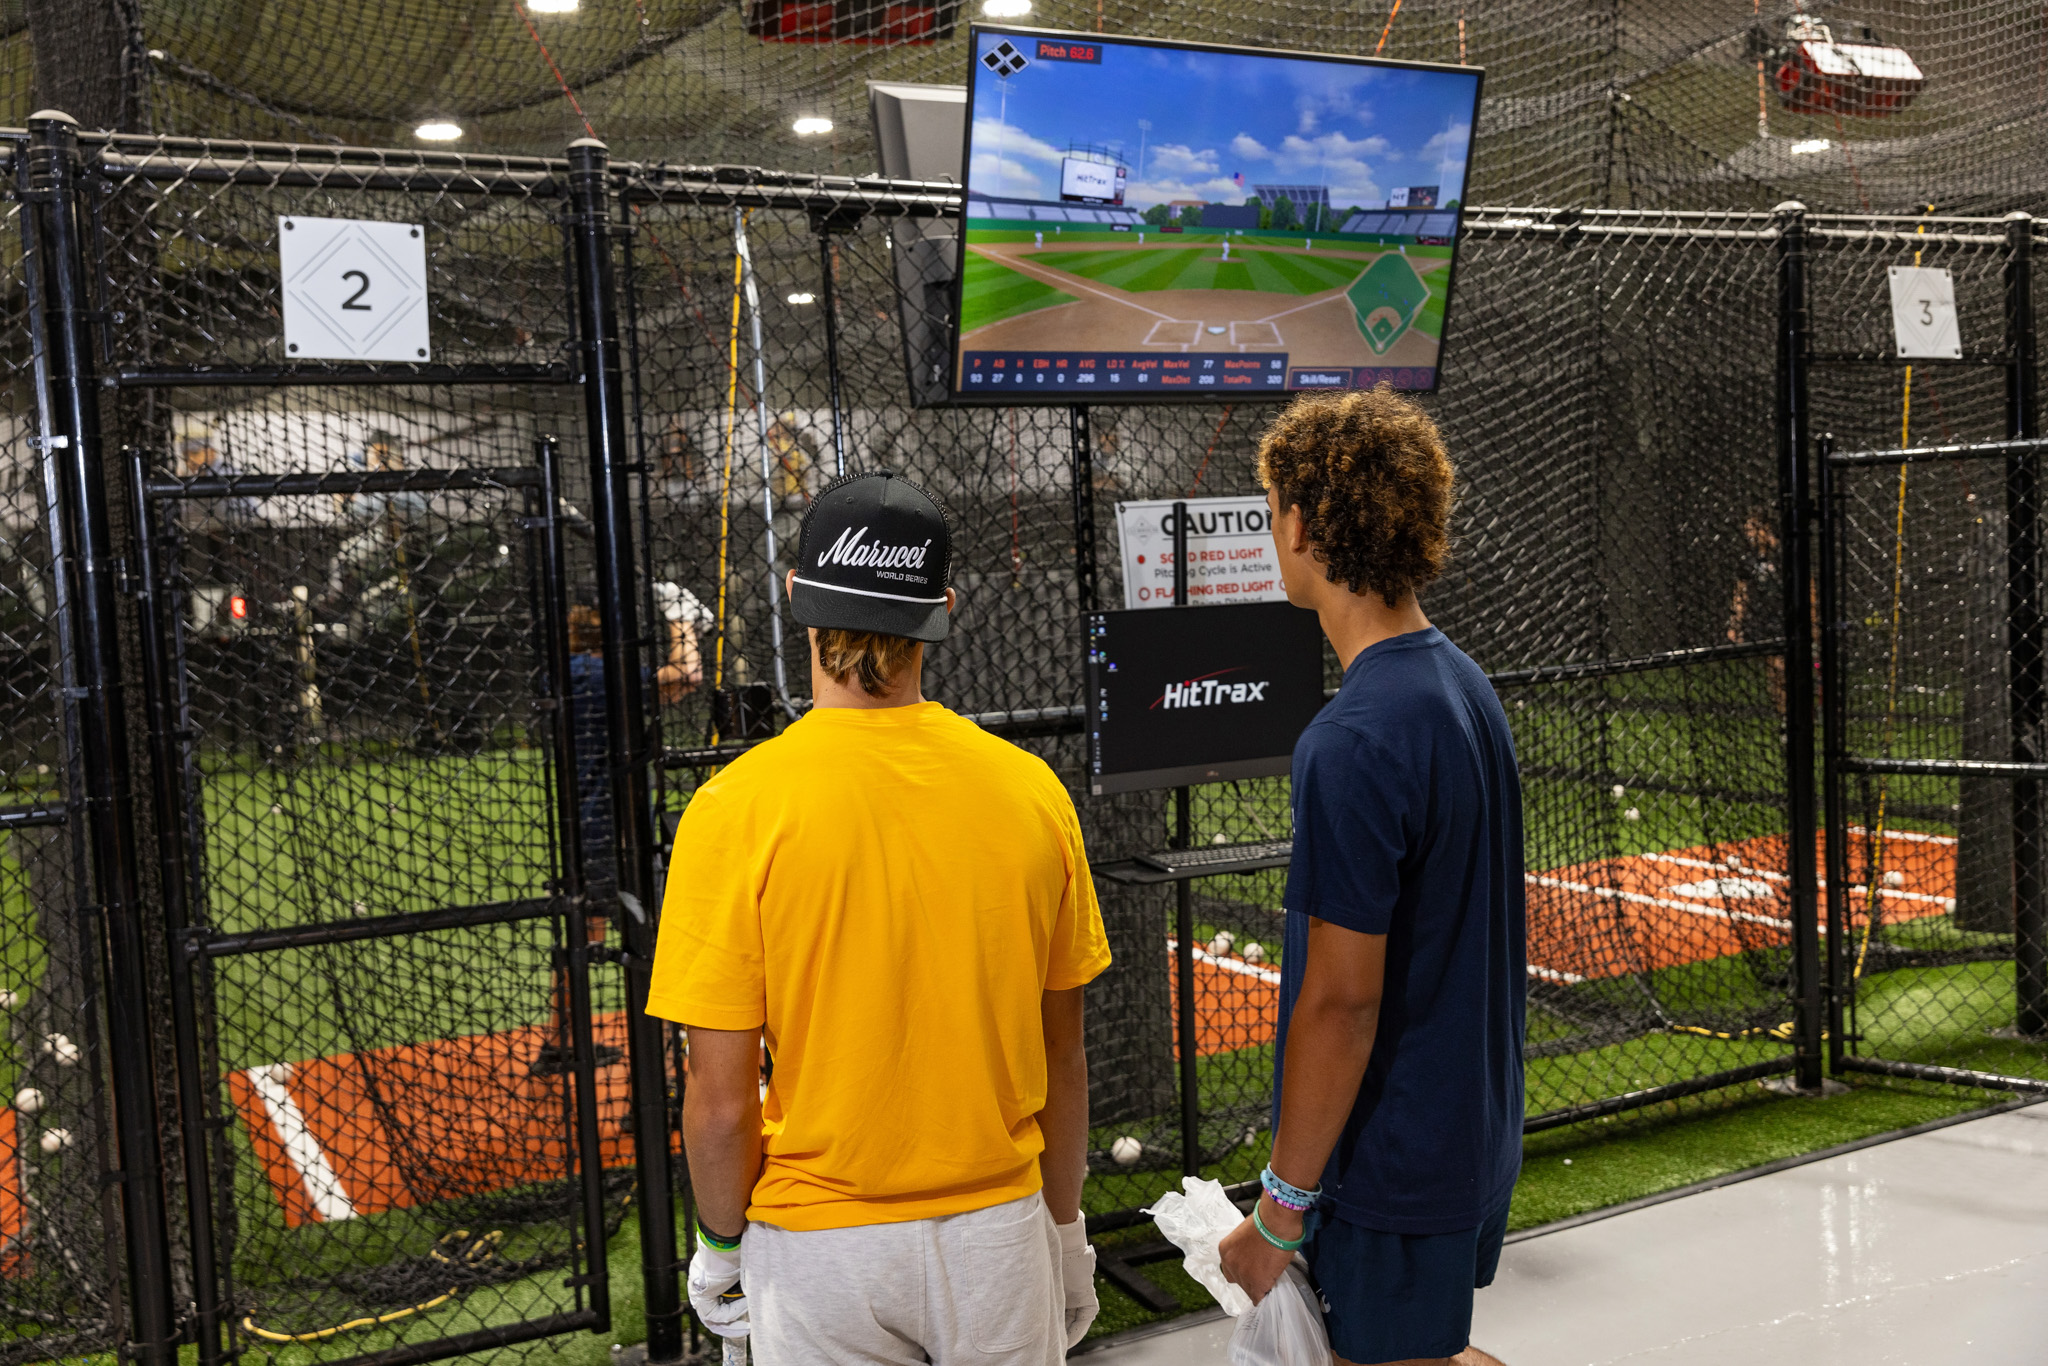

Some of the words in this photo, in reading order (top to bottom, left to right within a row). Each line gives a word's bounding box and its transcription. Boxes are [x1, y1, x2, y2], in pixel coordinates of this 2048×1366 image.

[1040, 44, 1067, 58] Pitch
[341, 270, 372, 311] 2
[1919, 299, 1934, 326] 3
[974, 358, 981, 368] P
[993, 358, 1006, 369] AB
[1016, 359, 1024, 368] H
[1056, 359, 1068, 369] HR
[1078, 359, 1096, 369] AVG
[1131, 360, 1158, 371] AvgVel
[1163, 360, 1191, 369] MaxVel
[1203, 359, 1215, 369] 77
[1224, 360, 1261, 369] MaxPoints
[992, 373, 1004, 384] 27
[1036, 373, 1045, 384] 0
[1057, 373, 1066, 384] 0
[1161, 375, 1191, 385] MaxDist
[817, 526, 932, 570] Marucci
[1160, 551, 1197, 565] SOD
[1200, 550, 1225, 562] RED
[1228, 548, 1264, 560] LIGHT
[876, 570, 904, 581] WORLD
[905, 573, 928, 584] SERIES
[1154, 568, 1196, 578] Pitcg
[1198, 564, 1226, 577] Cycle
[1229, 563, 1238, 574] is
[1241, 563, 1272, 573] Active
[1216, 583, 1240, 594] RED
[1242, 580, 1275, 593] LIGHT
[1163, 680, 1266, 709] HitTrax
